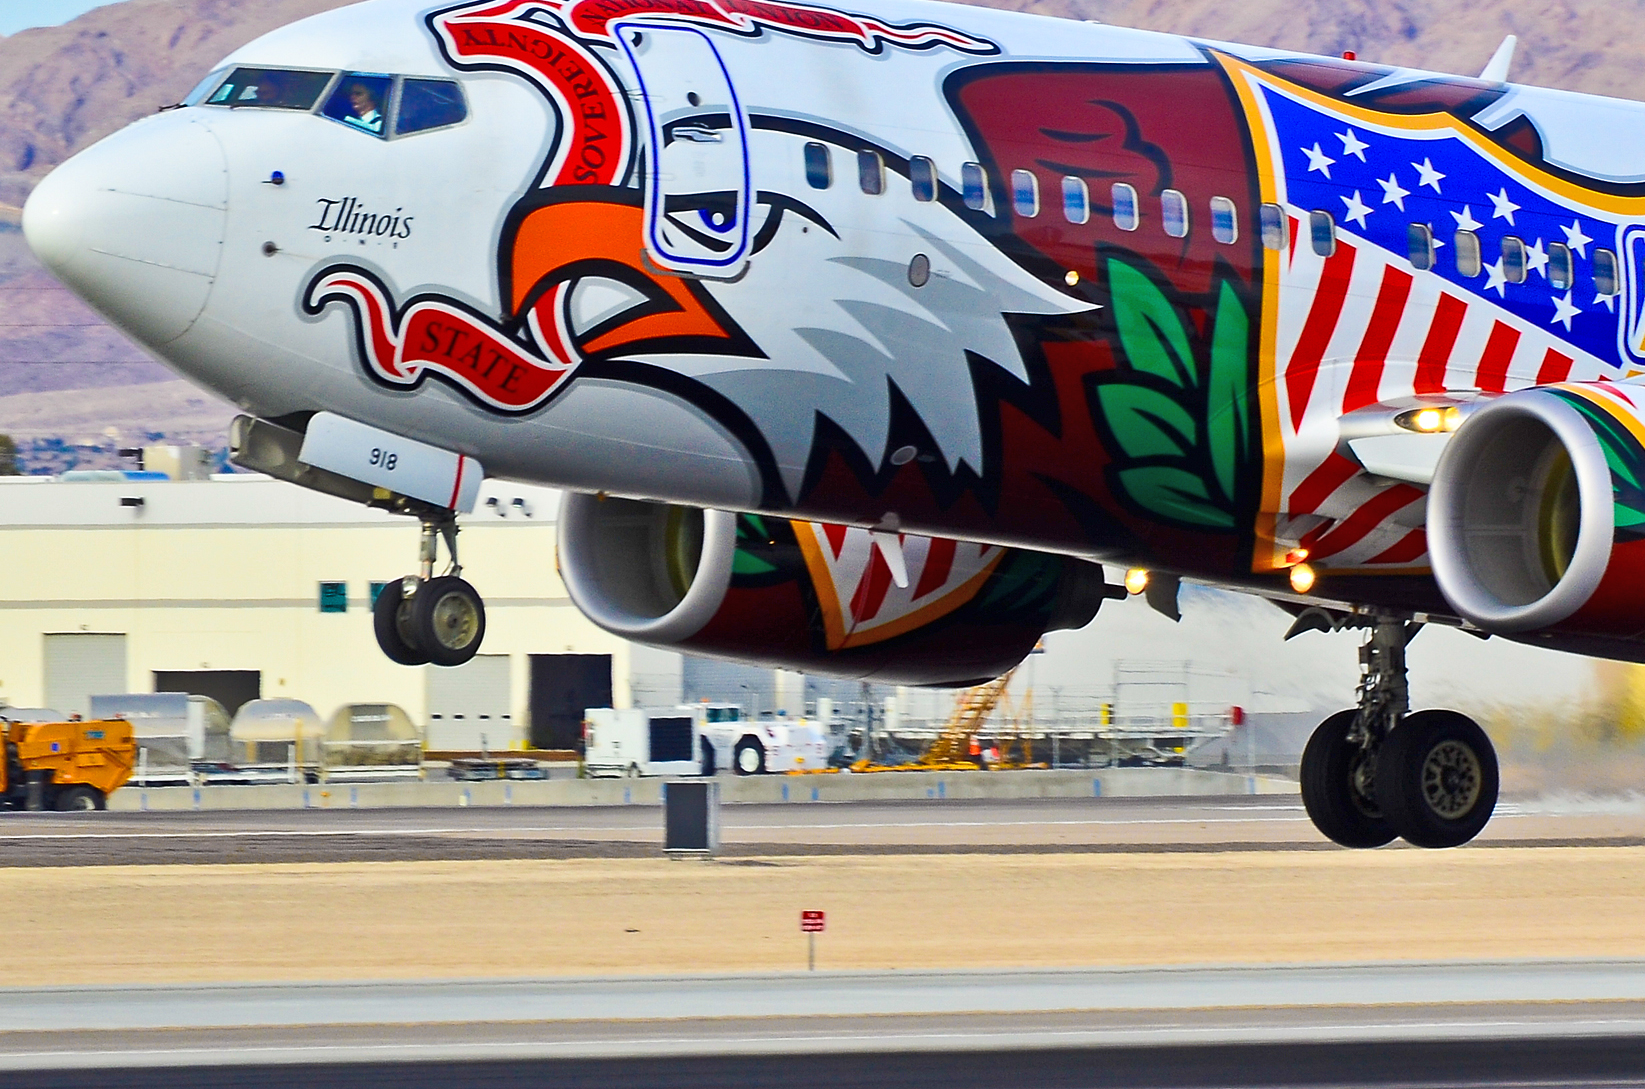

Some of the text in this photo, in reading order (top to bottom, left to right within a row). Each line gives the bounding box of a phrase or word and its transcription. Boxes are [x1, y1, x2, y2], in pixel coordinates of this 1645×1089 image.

[463, 28, 608, 185] SOVEREIGNTY
[308, 196, 415, 239] Illinois
[420, 321, 529, 394] STATE
[369, 447, 398, 471] 918
